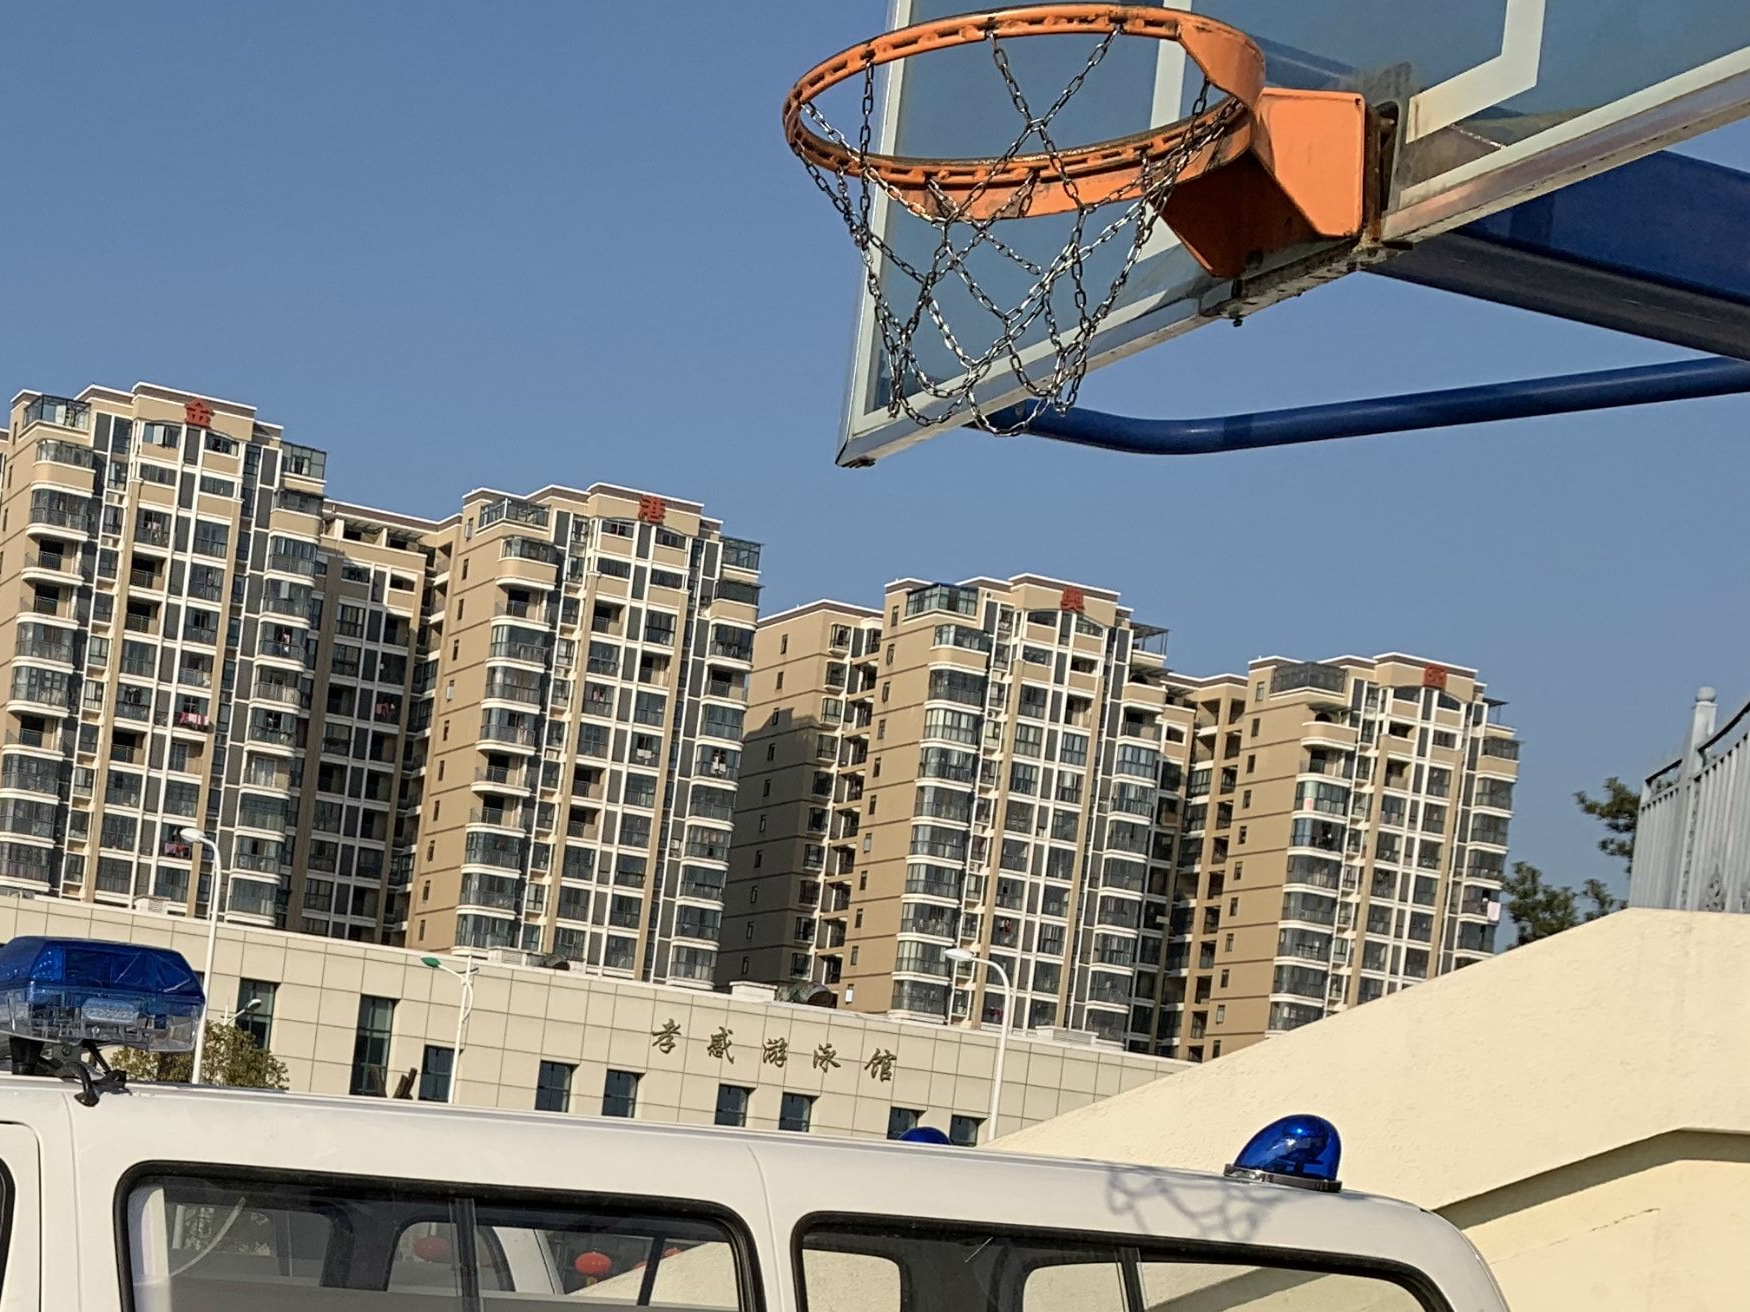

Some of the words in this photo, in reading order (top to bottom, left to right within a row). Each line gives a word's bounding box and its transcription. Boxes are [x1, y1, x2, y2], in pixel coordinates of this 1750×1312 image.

[185, 397, 214, 427] 金
[639, 494, 665, 524] 港
[651, 1018, 898, 1083] 孝感游泳馆
